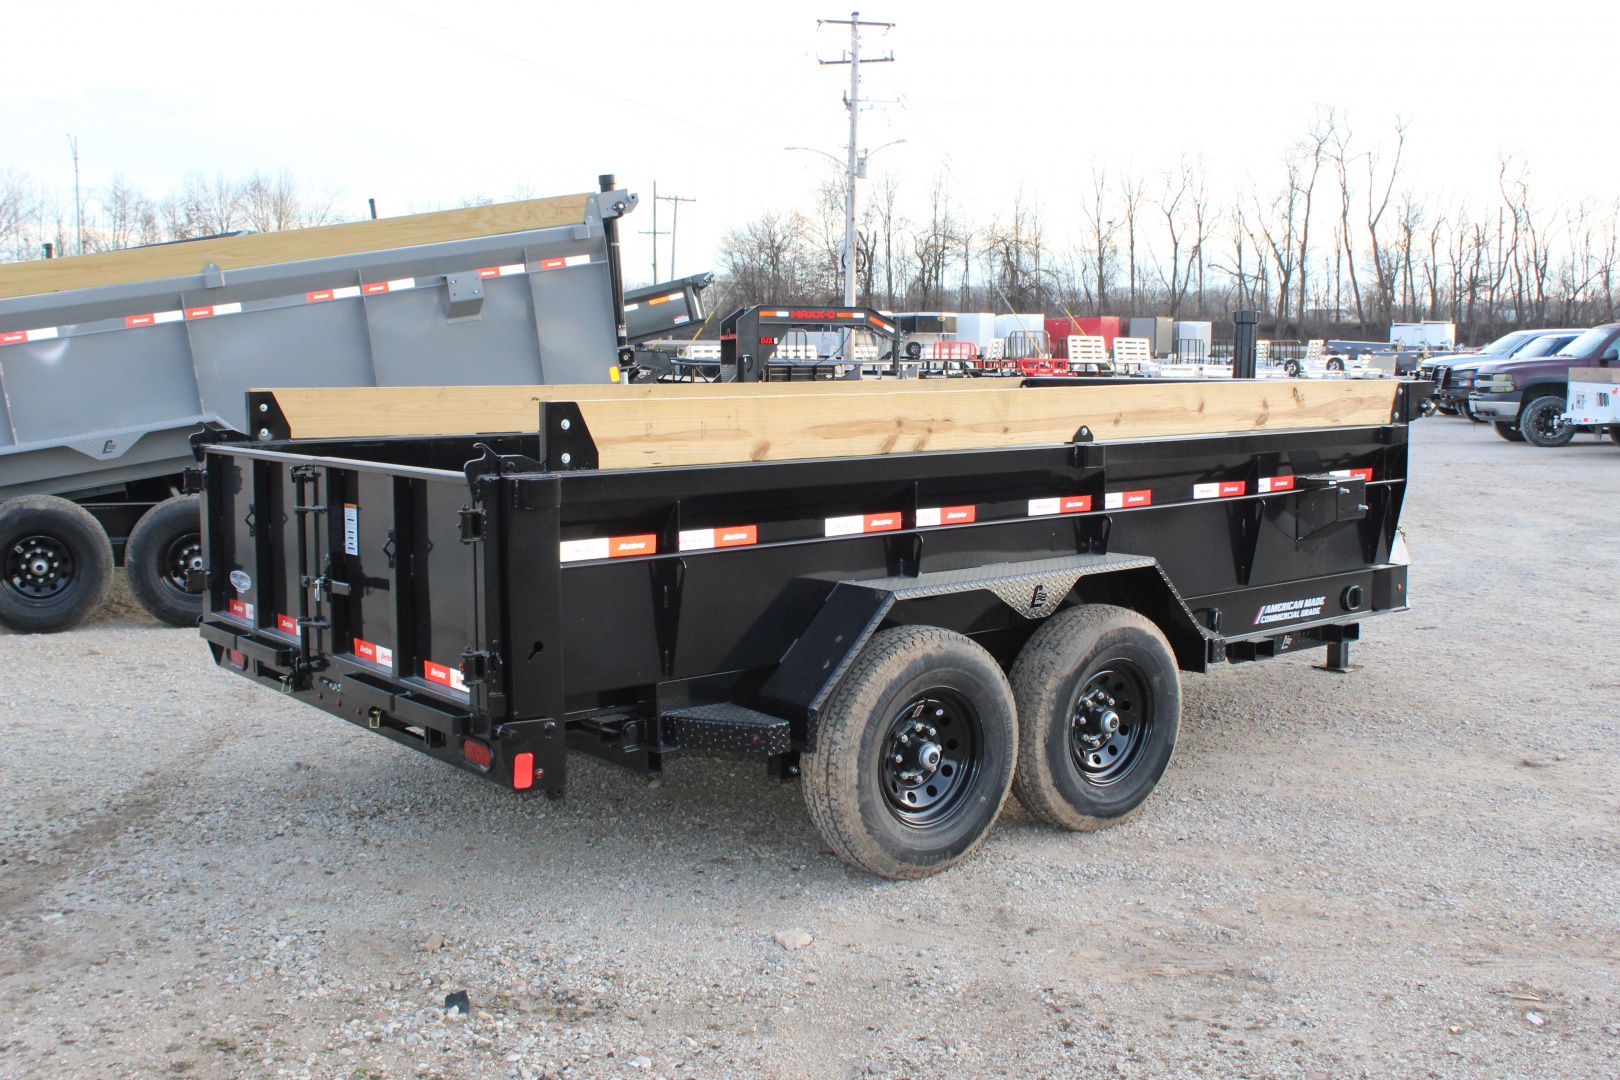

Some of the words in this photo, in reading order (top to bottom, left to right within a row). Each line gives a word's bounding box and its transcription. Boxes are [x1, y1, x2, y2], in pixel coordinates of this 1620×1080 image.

[791, 311, 835, 319] MAXX-D
[1264, 600, 1304, 614] AMERICAN
[1303, 596, 1327, 608] MADE
[1260, 611, 1301, 624] COMMERCIAL
[1300, 607, 1322, 618] GRADE
